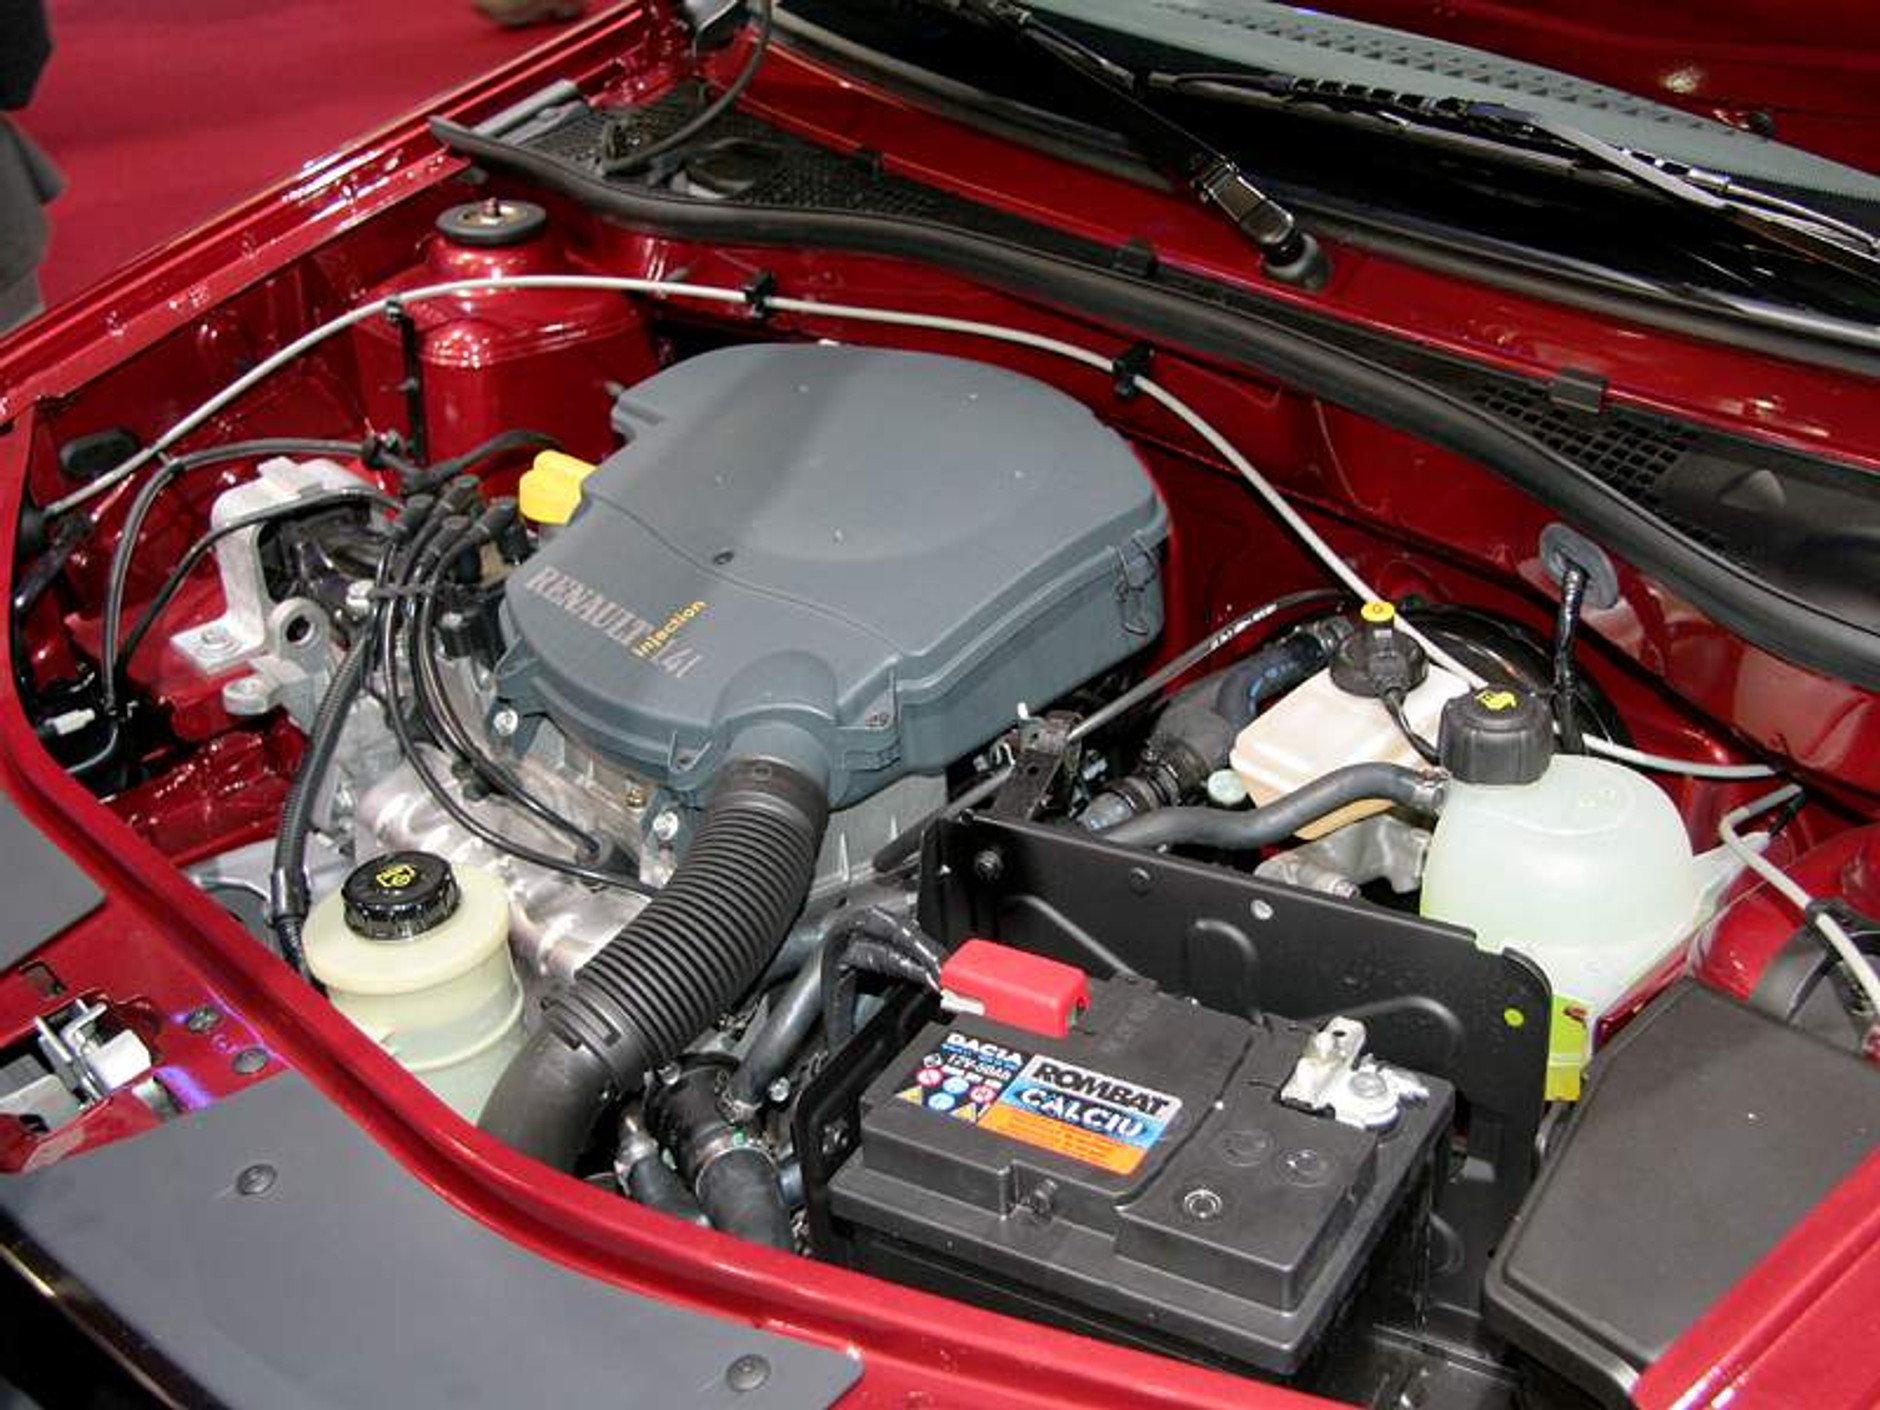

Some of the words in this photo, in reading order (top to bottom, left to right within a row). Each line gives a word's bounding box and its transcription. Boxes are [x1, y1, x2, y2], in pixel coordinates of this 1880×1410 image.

[525, 565, 655, 646] RENAULT
[946, 1032, 1023, 1067] DACIA
[1020, 1086, 1144, 1138] CALCIU
[1032, 1062, 1170, 1115] ROMBAT
